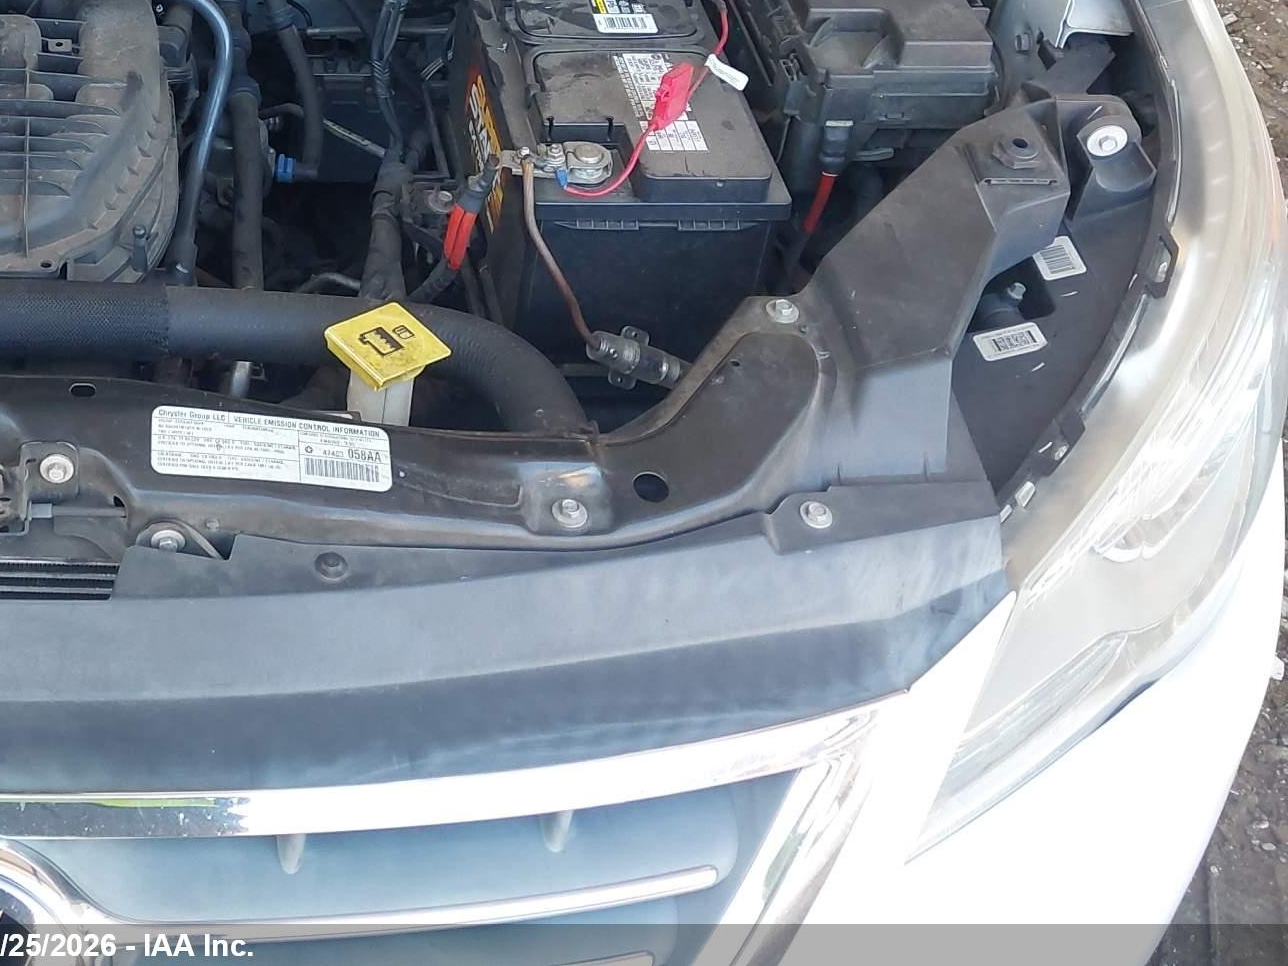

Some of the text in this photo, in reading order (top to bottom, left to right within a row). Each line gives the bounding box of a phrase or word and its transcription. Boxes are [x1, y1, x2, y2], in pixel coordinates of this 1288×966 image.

[158, 409, 225, 421] Chrysler Group LLC
[234, 416, 261, 424] VEHICLE
[264, 418, 297, 428] EMISSION
[298, 422, 330, 432] CONTROL
[332, 426, 380, 437] INFORMATION
[347, 448, 382, 463] 058AA
